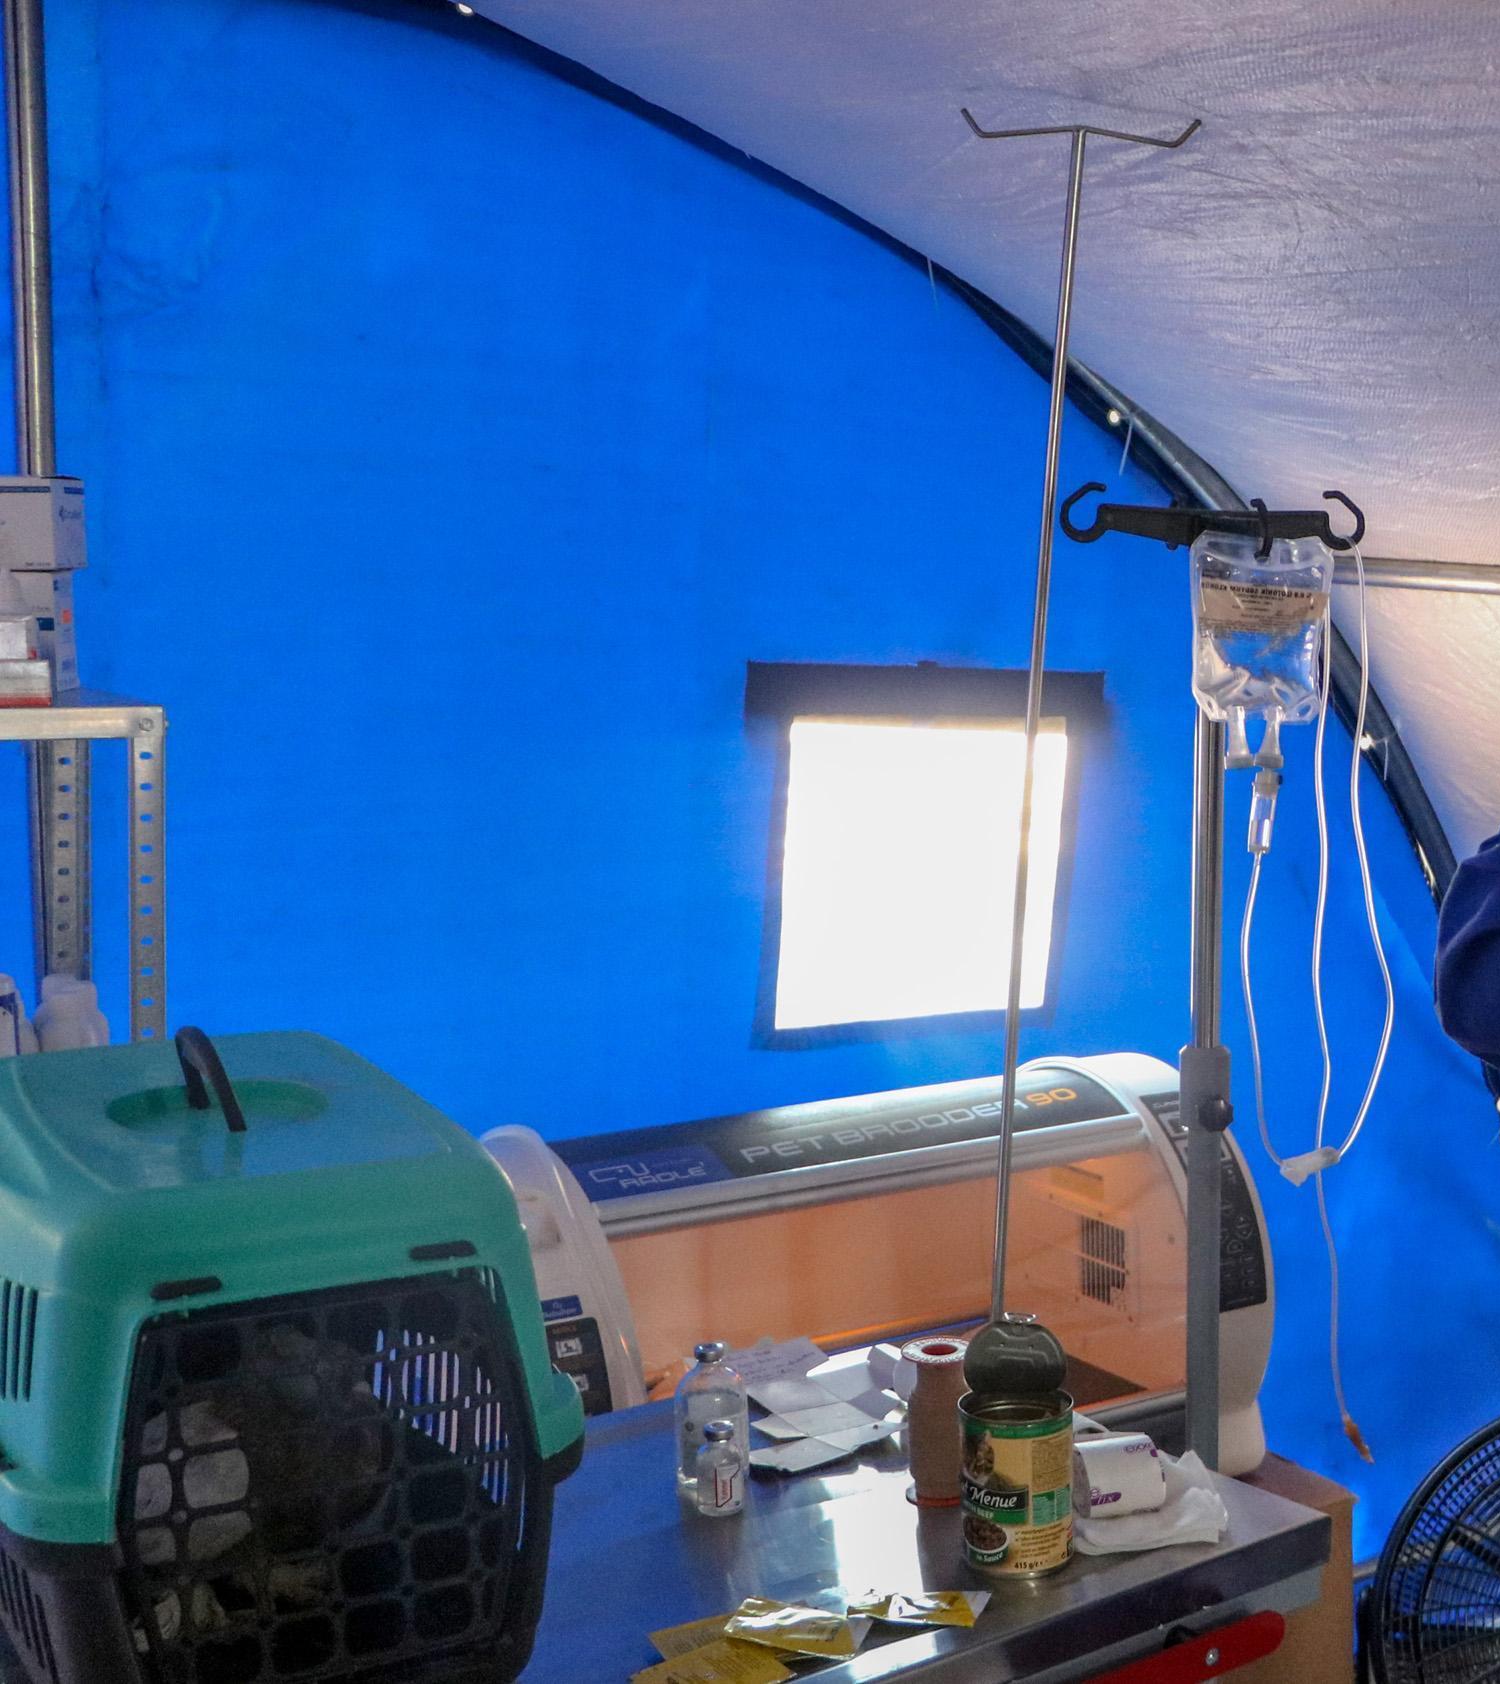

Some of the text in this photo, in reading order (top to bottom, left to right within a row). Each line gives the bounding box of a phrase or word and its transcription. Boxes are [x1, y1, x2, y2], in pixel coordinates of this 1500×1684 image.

[739, 1134, 827, 1164] PET
[1026, 1086, 1078, 1107] 90
[969, 1486, 1018, 1508] Menue
